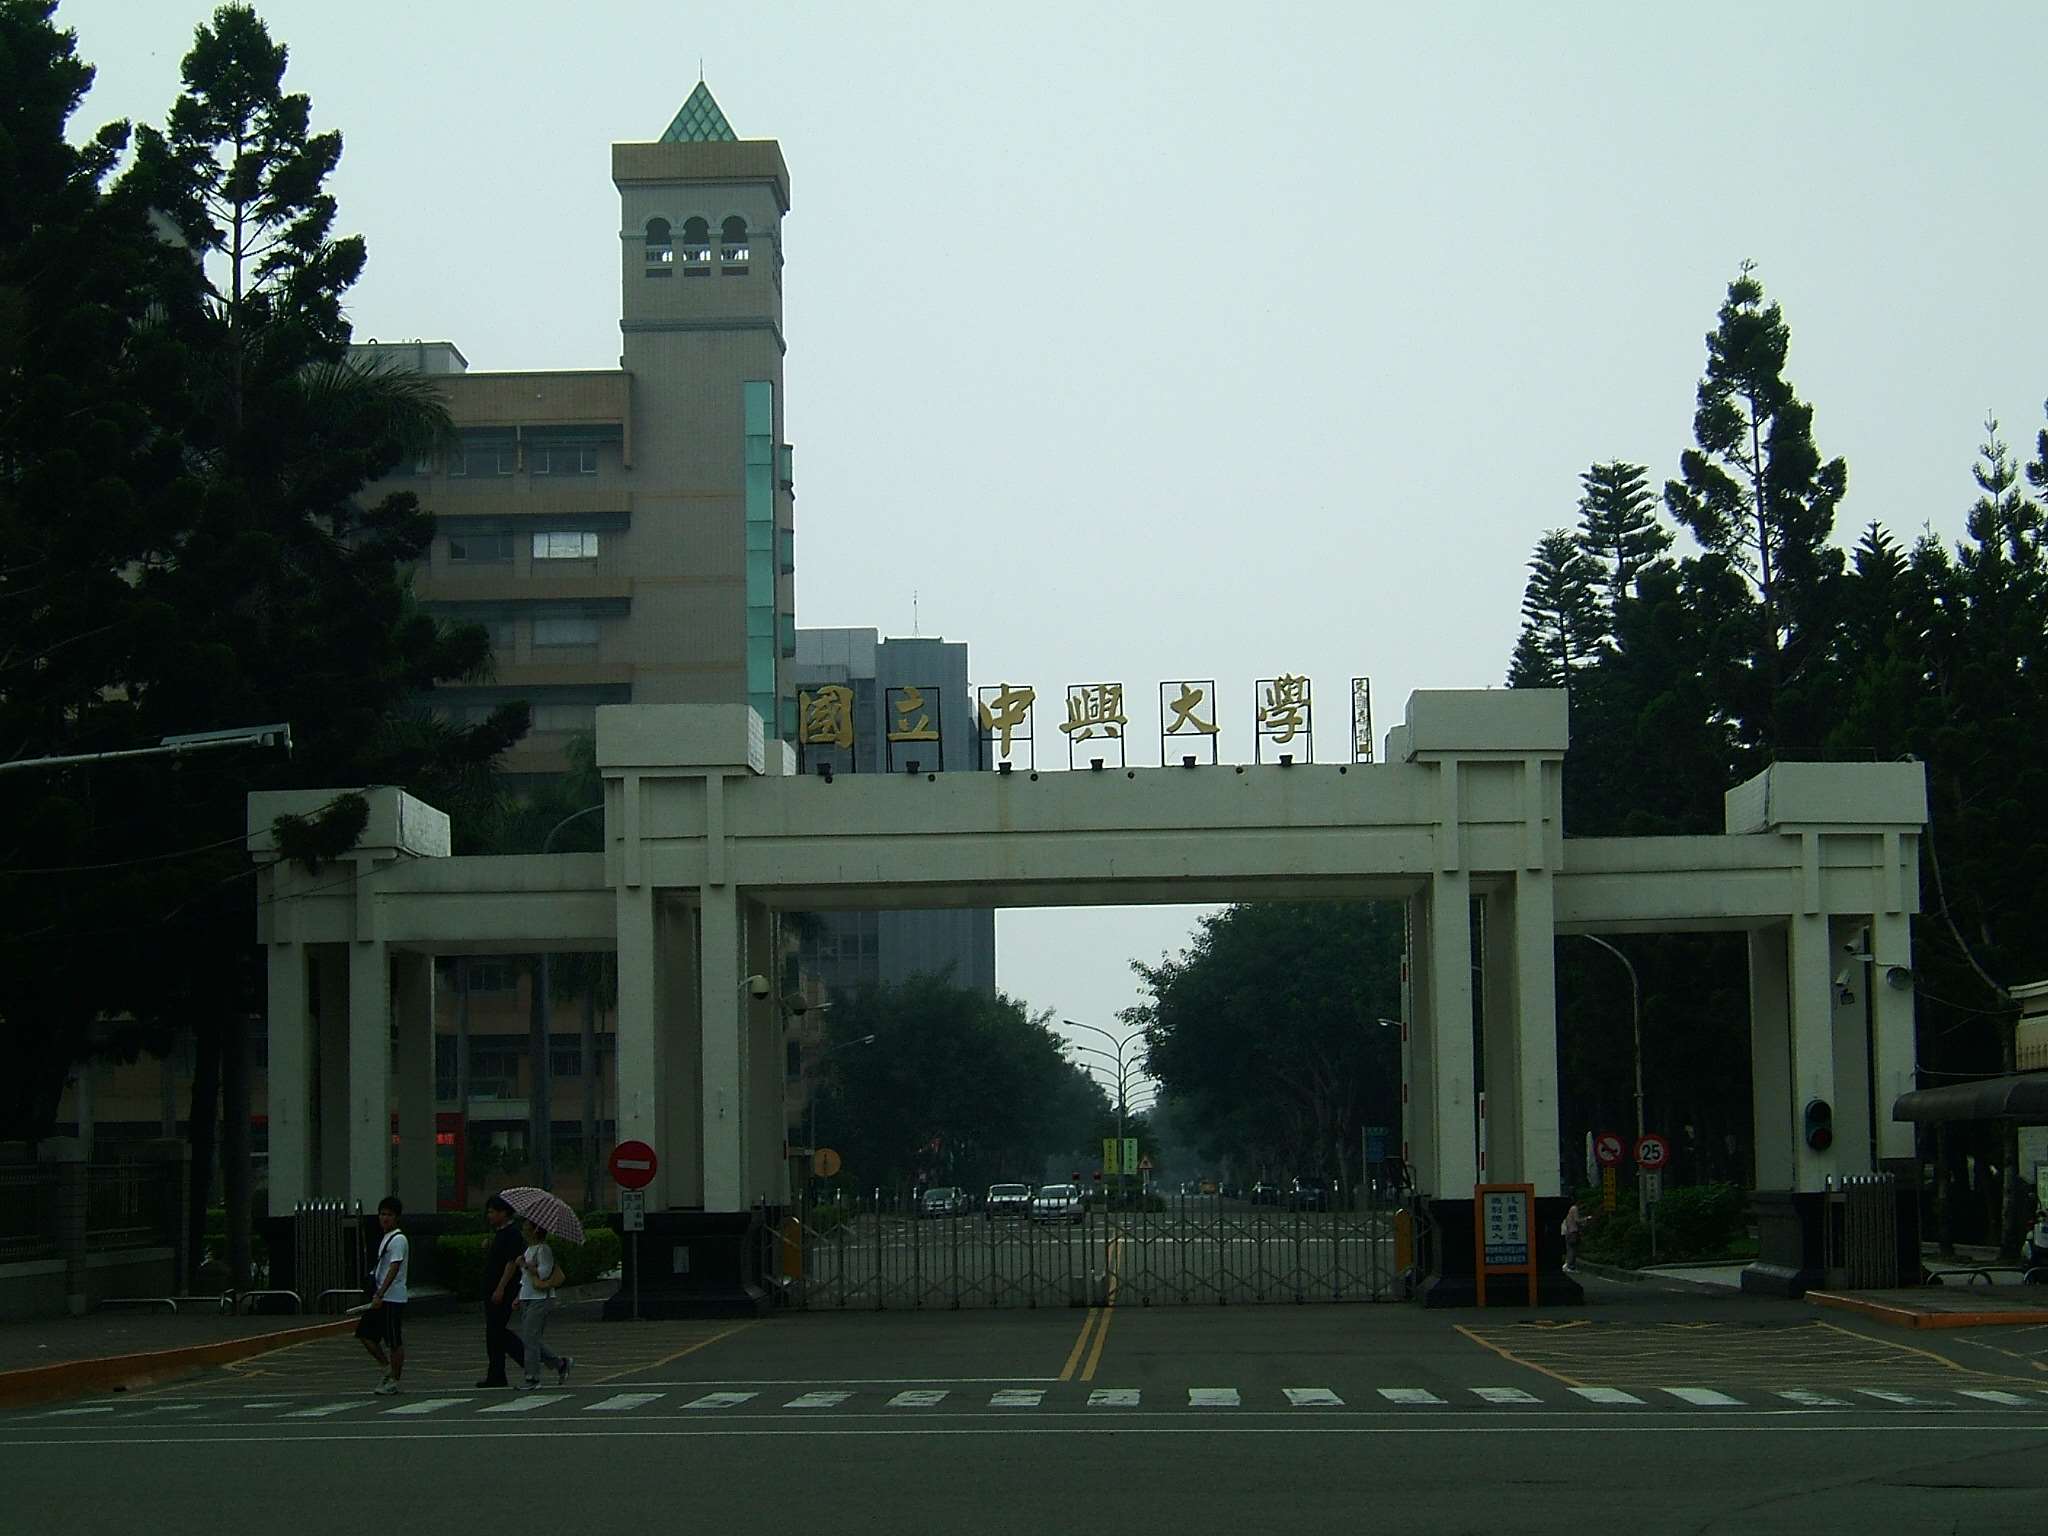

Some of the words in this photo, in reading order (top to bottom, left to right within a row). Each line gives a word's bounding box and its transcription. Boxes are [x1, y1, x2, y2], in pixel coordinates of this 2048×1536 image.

[798, 672, 1312, 757] 國立中興大學
[1642, 1144, 1661, 1160] 25
